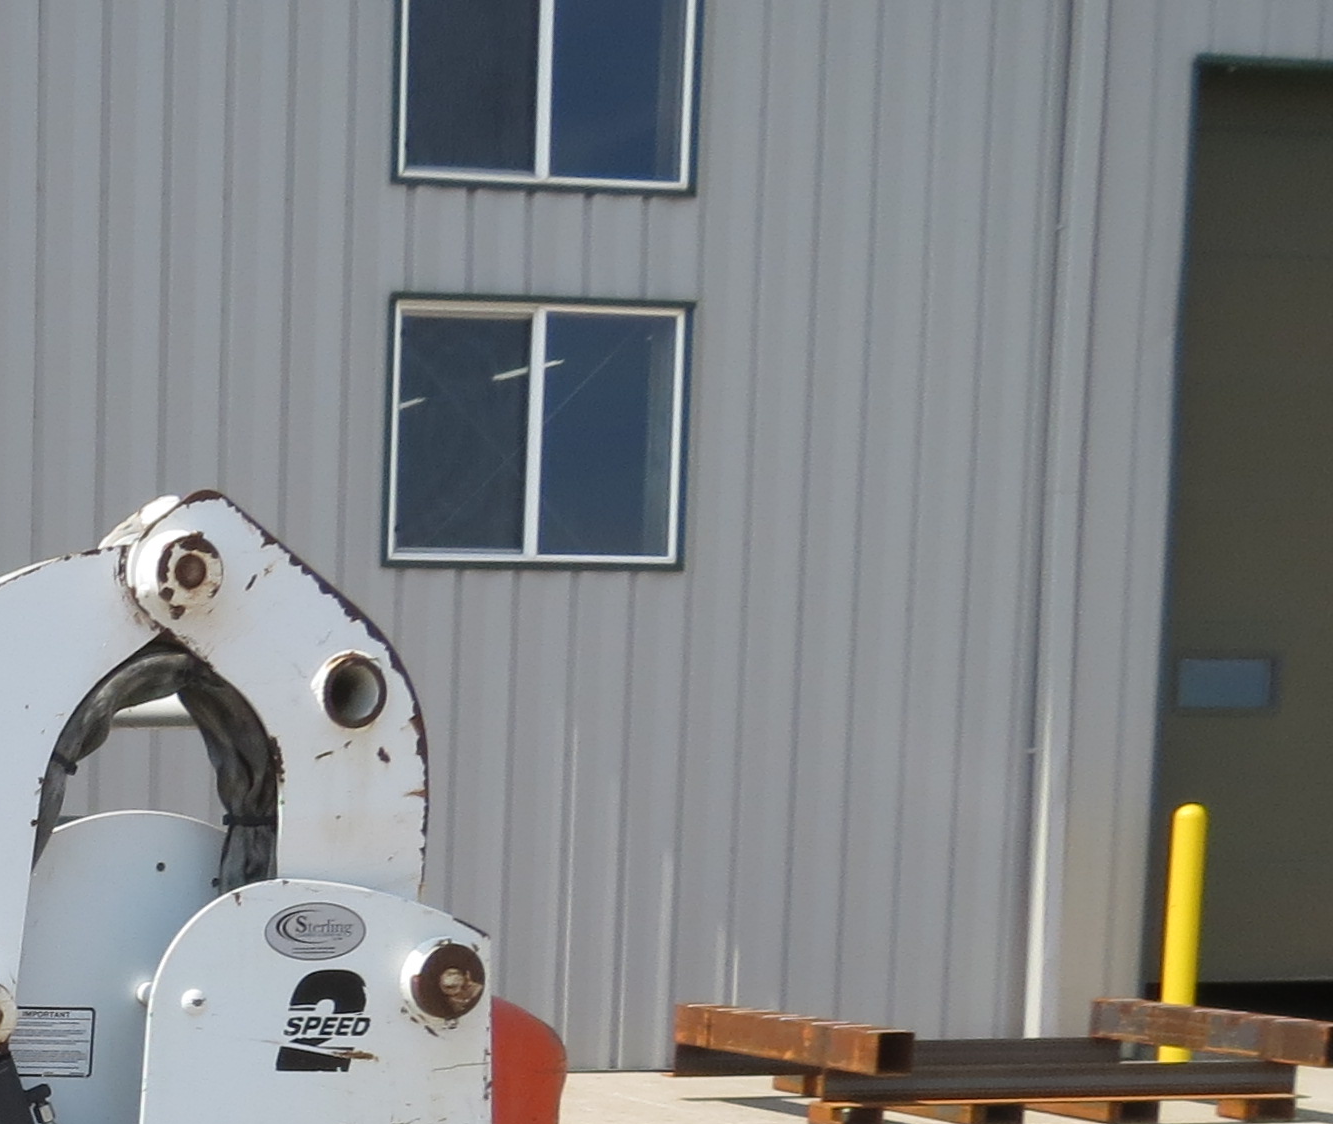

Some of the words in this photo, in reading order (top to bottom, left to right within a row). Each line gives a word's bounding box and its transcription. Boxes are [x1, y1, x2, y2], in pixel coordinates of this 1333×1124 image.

[295, 915, 354, 937] Sterling
[276, 969, 367, 1072] 2
[283, 1016, 371, 1036] SPEED
